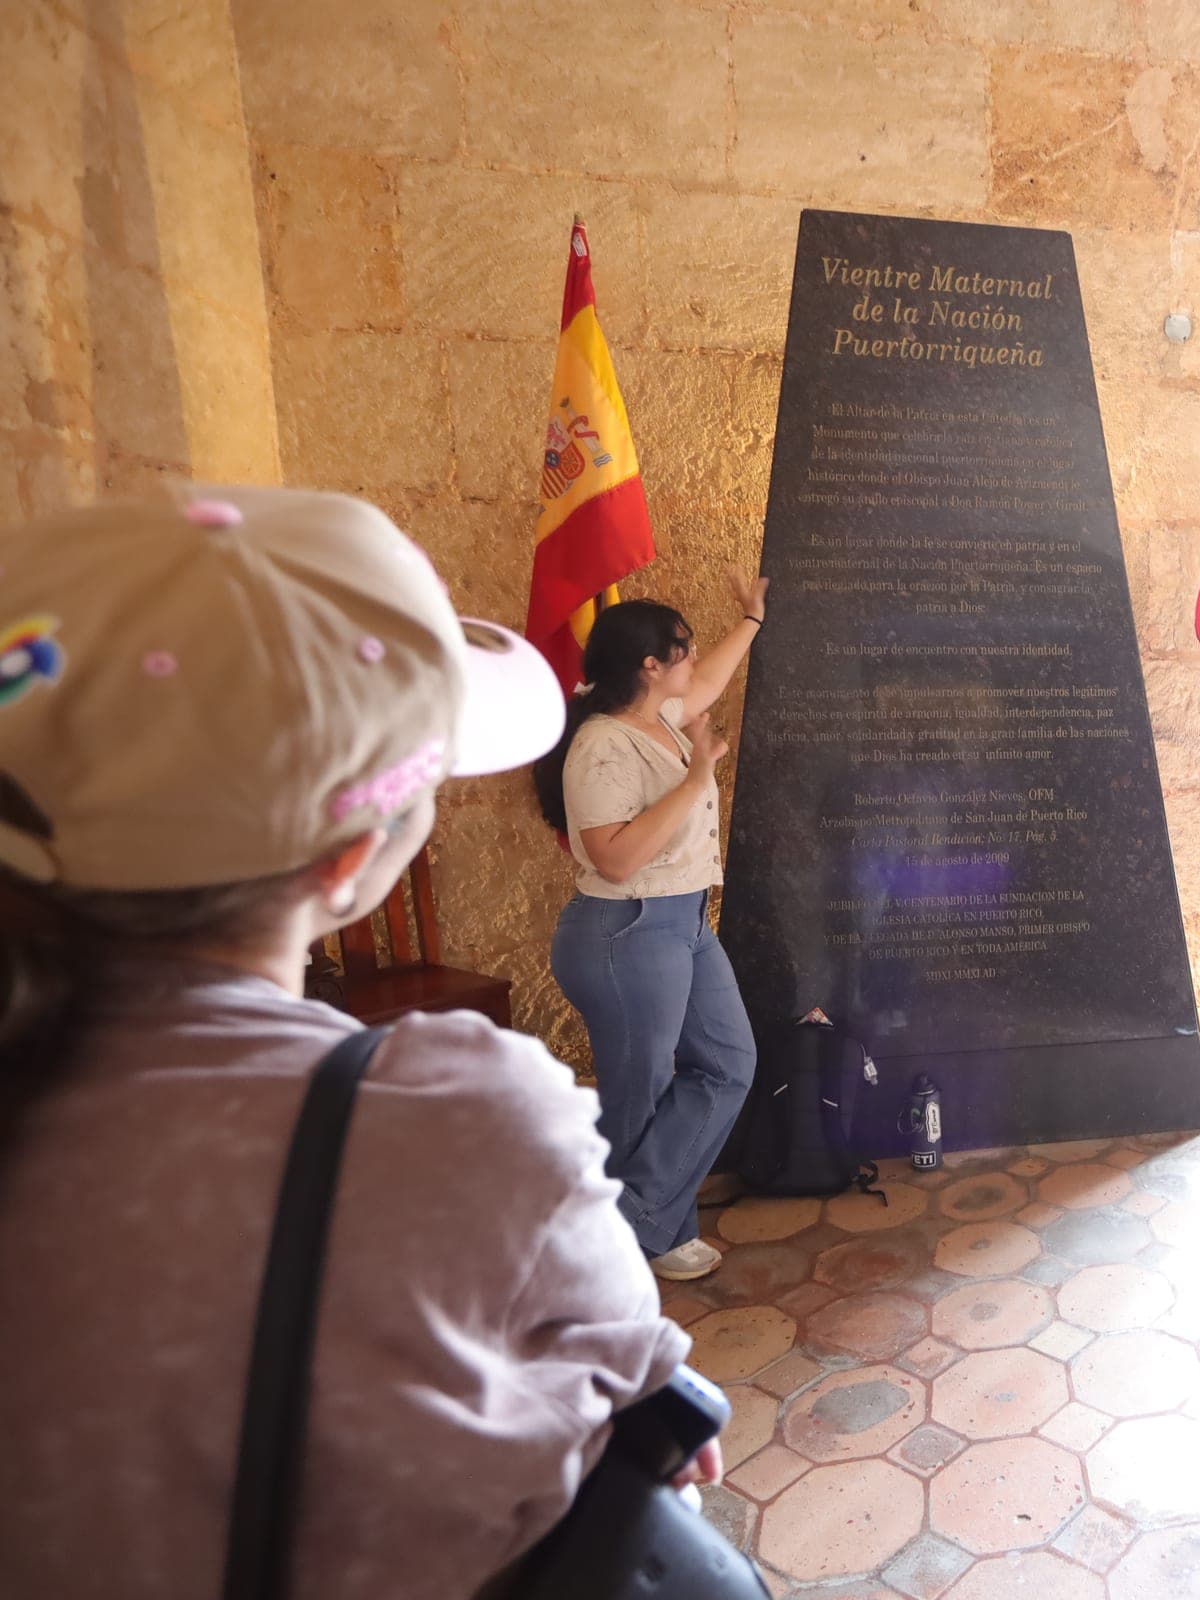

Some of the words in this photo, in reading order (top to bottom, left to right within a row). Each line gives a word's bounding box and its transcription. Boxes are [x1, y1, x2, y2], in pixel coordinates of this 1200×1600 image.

[821, 256, 921, 290] Vientre
[928, 266, 1053, 300] Maternal
[852, 296, 884, 322] de
[893, 299, 920, 324] la
[928, 300, 1023, 332] Nación
[831, 328, 1044, 369] Puertorriqueña
[813, 424, 878, 440] Monumento
[881, 431, 900, 445] que
[904, 471, 941, 489] Obispo
[876, 534, 908, 549] donde
[1015, 539, 1046, 555] patria
[1066, 561, 1102, 577] espacio
[843, 646, 857, 655] un
[860, 642, 888, 659] lugar
[891, 642, 902, 655] de
[905, 643, 958, 655] encuentro
[960, 646, 978, 655] con
[981, 643, 1019, 655] nuestra
[976, 688, 1024, 702] promover
[1027, 685, 1070, 698] nuestros
[890, 706, 903, 719] de
[1096, 707, 1113, 721] paz
[1055, 725, 1068, 739] de
[1070, 725, 1085, 738] las
[1088, 726, 1129, 738] naciones
[874, 747, 897, 761] Dios
[900, 747, 913, 761] ha
[915, 747, 950, 760] creado
[985, 746, 1023, 760] infinito
[1028, 787, 1055, 801] OFM
[951, 811, 963, 824] de
[965, 810, 985, 824] San
[987, 810, 1013, 823] Juan
[1016, 809, 1028, 822] de
[1030, 808, 1064, 822] Puerto
[1066, 807, 1088, 821] Rico
[935, 852, 969, 869] agosto
[971, 850, 983, 864] de
[1058, 888, 1071, 901] DE
[1073, 887, 1085, 901] LA
[1019, 920, 1055, 935] PRIMER
[1057, 919, 1092, 933] OBISPO
[976, 941, 1001, 955] TODA
[913, 1155, 933, 1165] ETI
